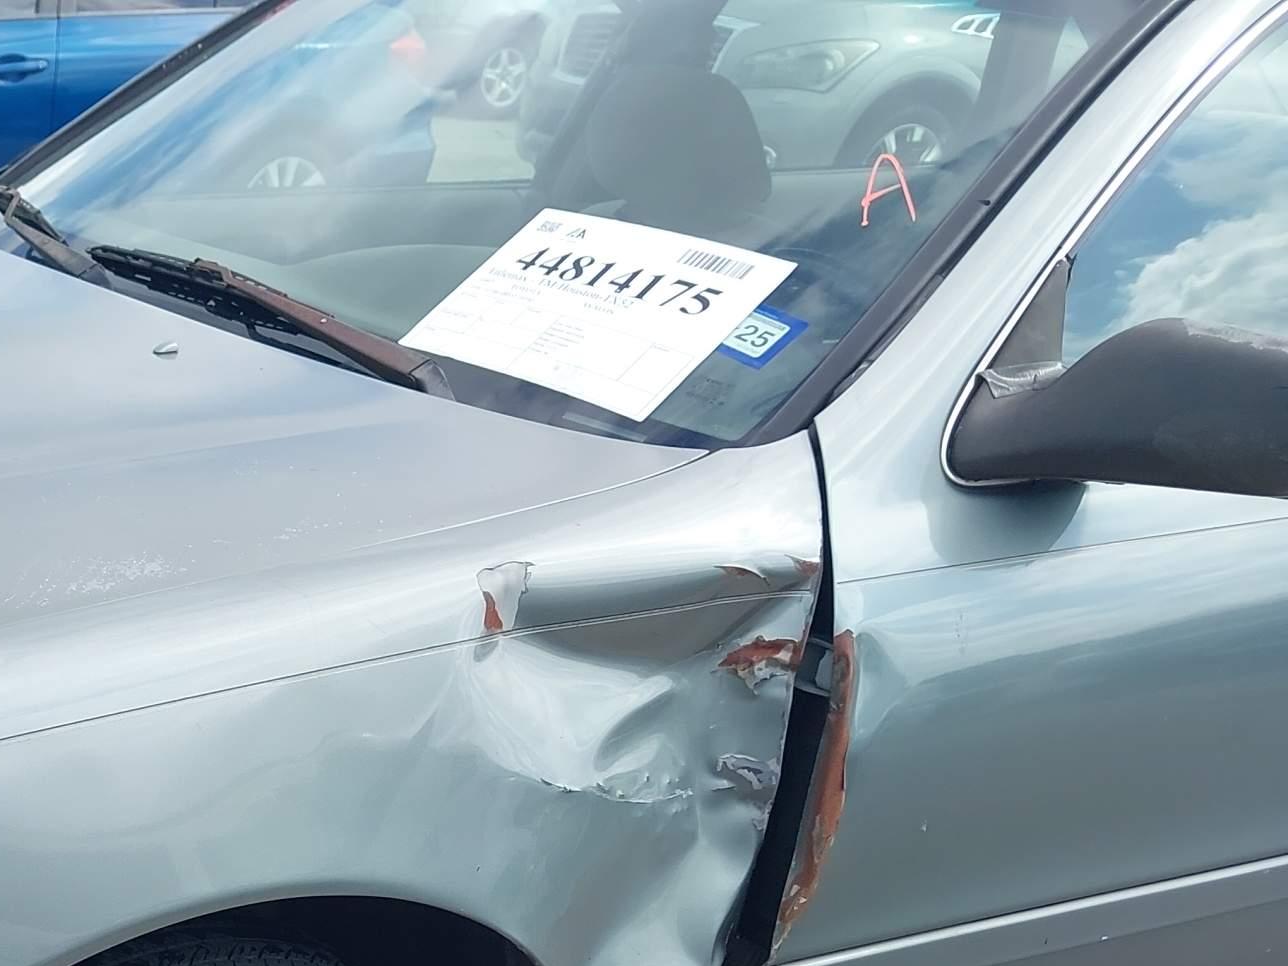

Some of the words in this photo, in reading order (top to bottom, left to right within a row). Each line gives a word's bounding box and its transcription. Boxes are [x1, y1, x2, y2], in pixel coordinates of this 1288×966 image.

[860, 152, 916, 227] A
[515, 247, 724, 316] 44814175
[733, 324, 776, 348] 25
